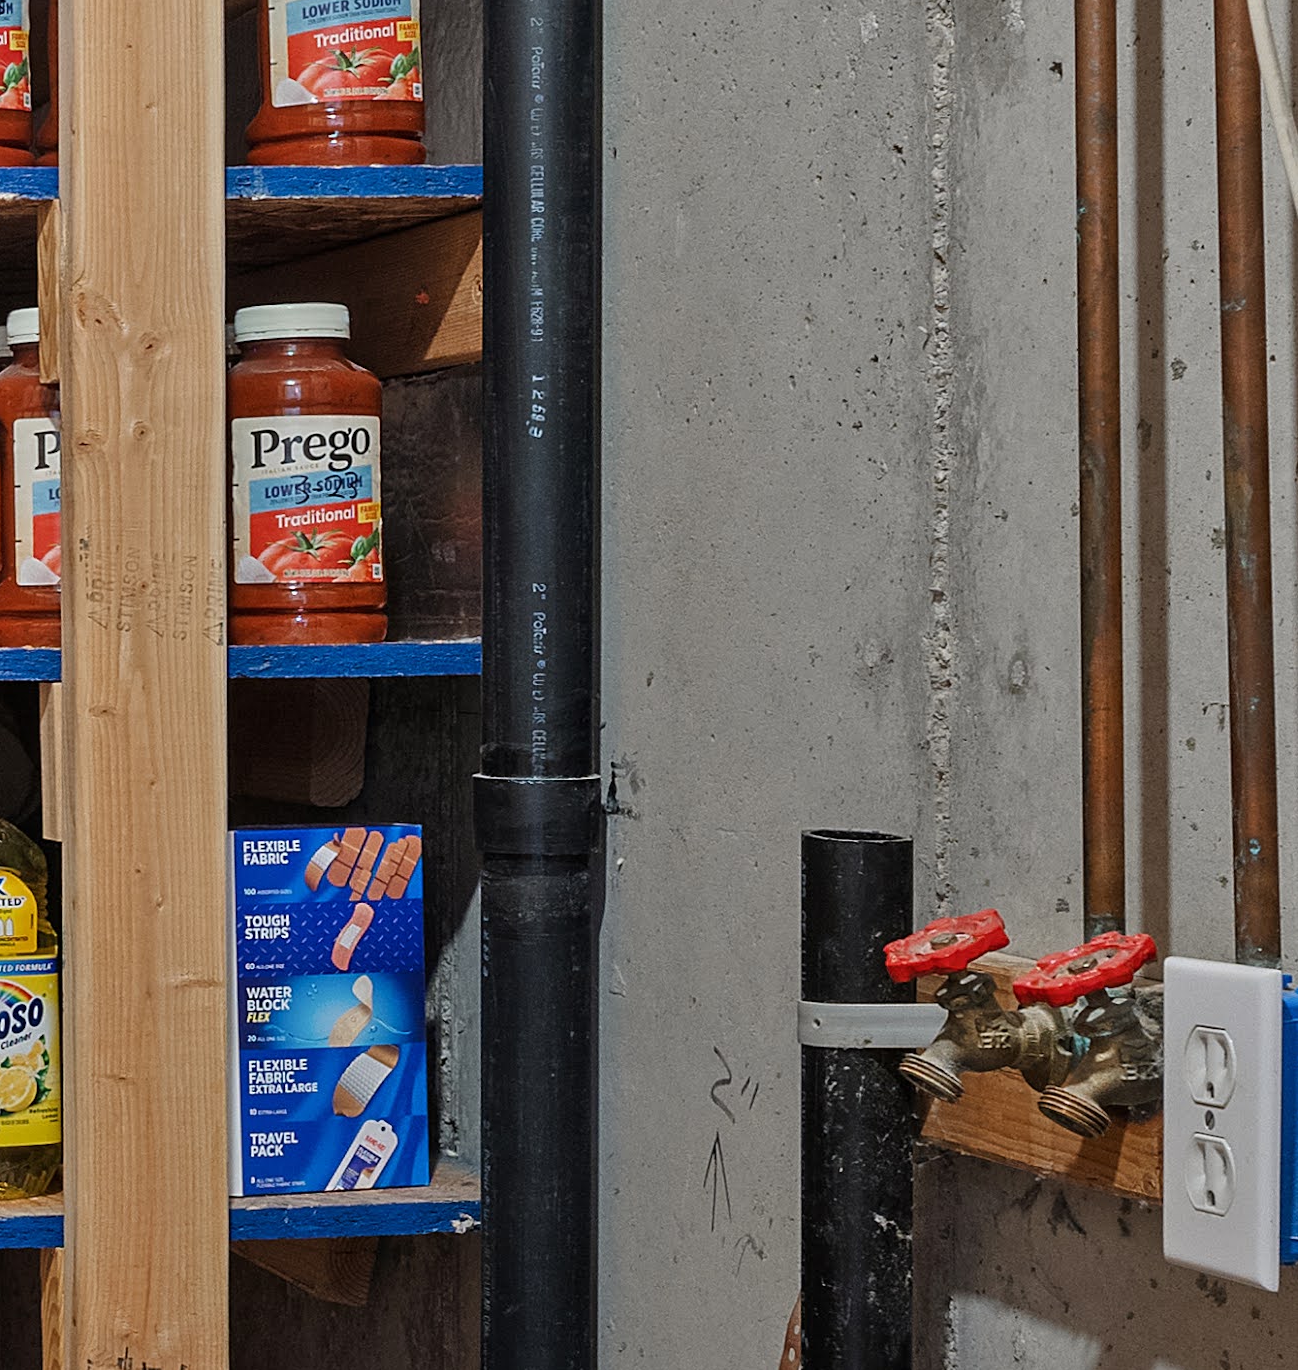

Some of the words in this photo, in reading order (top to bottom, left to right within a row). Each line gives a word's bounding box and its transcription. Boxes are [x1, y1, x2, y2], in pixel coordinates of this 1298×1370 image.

[302, 0, 350, 19] LOWER
[314, 22, 394, 48] Traditional
[250, 428, 371, 472] Prego
[276, 505, 355, 528] Traditional
[242, 840, 301, 853] FLEXIBLE
[243, 853, 289, 865] FABRIC
[244, 914, 290, 928] TOUGH
[245, 927, 290, 939] STRIPS
[15, 962, 51, 973] FORMULA
[246, 986, 292, 999] WATER
[247, 999, 291, 1011] BLOCK
[246, 1012, 271, 1023] FLEX
[0, 1032, 32, 1050] Cleaner
[248, 1059, 308, 1072] FLEXIBLE
[248, 1071, 295, 1084] FABRIC
[249, 1084, 283, 1095] EXTRA
[285, 1082, 318, 1093] LARGE
[250, 1132, 298, 1145] TRAVEL
[250, 1144, 284, 1157] PACK
